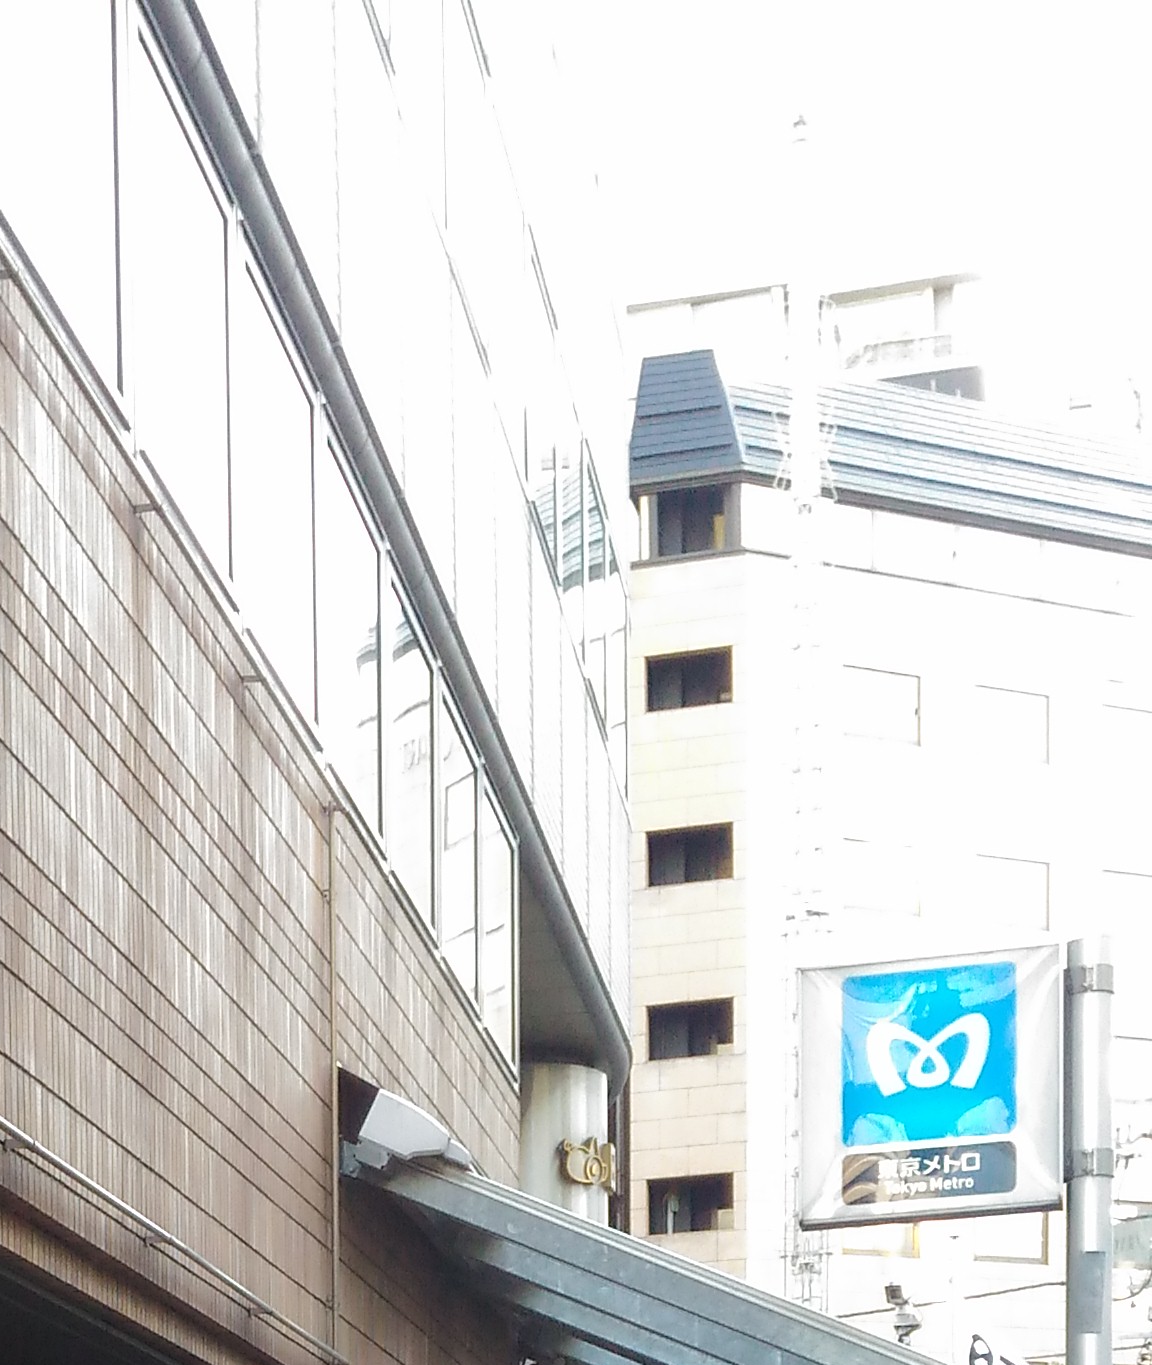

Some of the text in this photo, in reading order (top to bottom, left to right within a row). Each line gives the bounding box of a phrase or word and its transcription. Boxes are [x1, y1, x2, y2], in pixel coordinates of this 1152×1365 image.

[877, 1152, 981, 1180] 東京メトロ
[885, 1176, 975, 1197] Tokyo Metro
